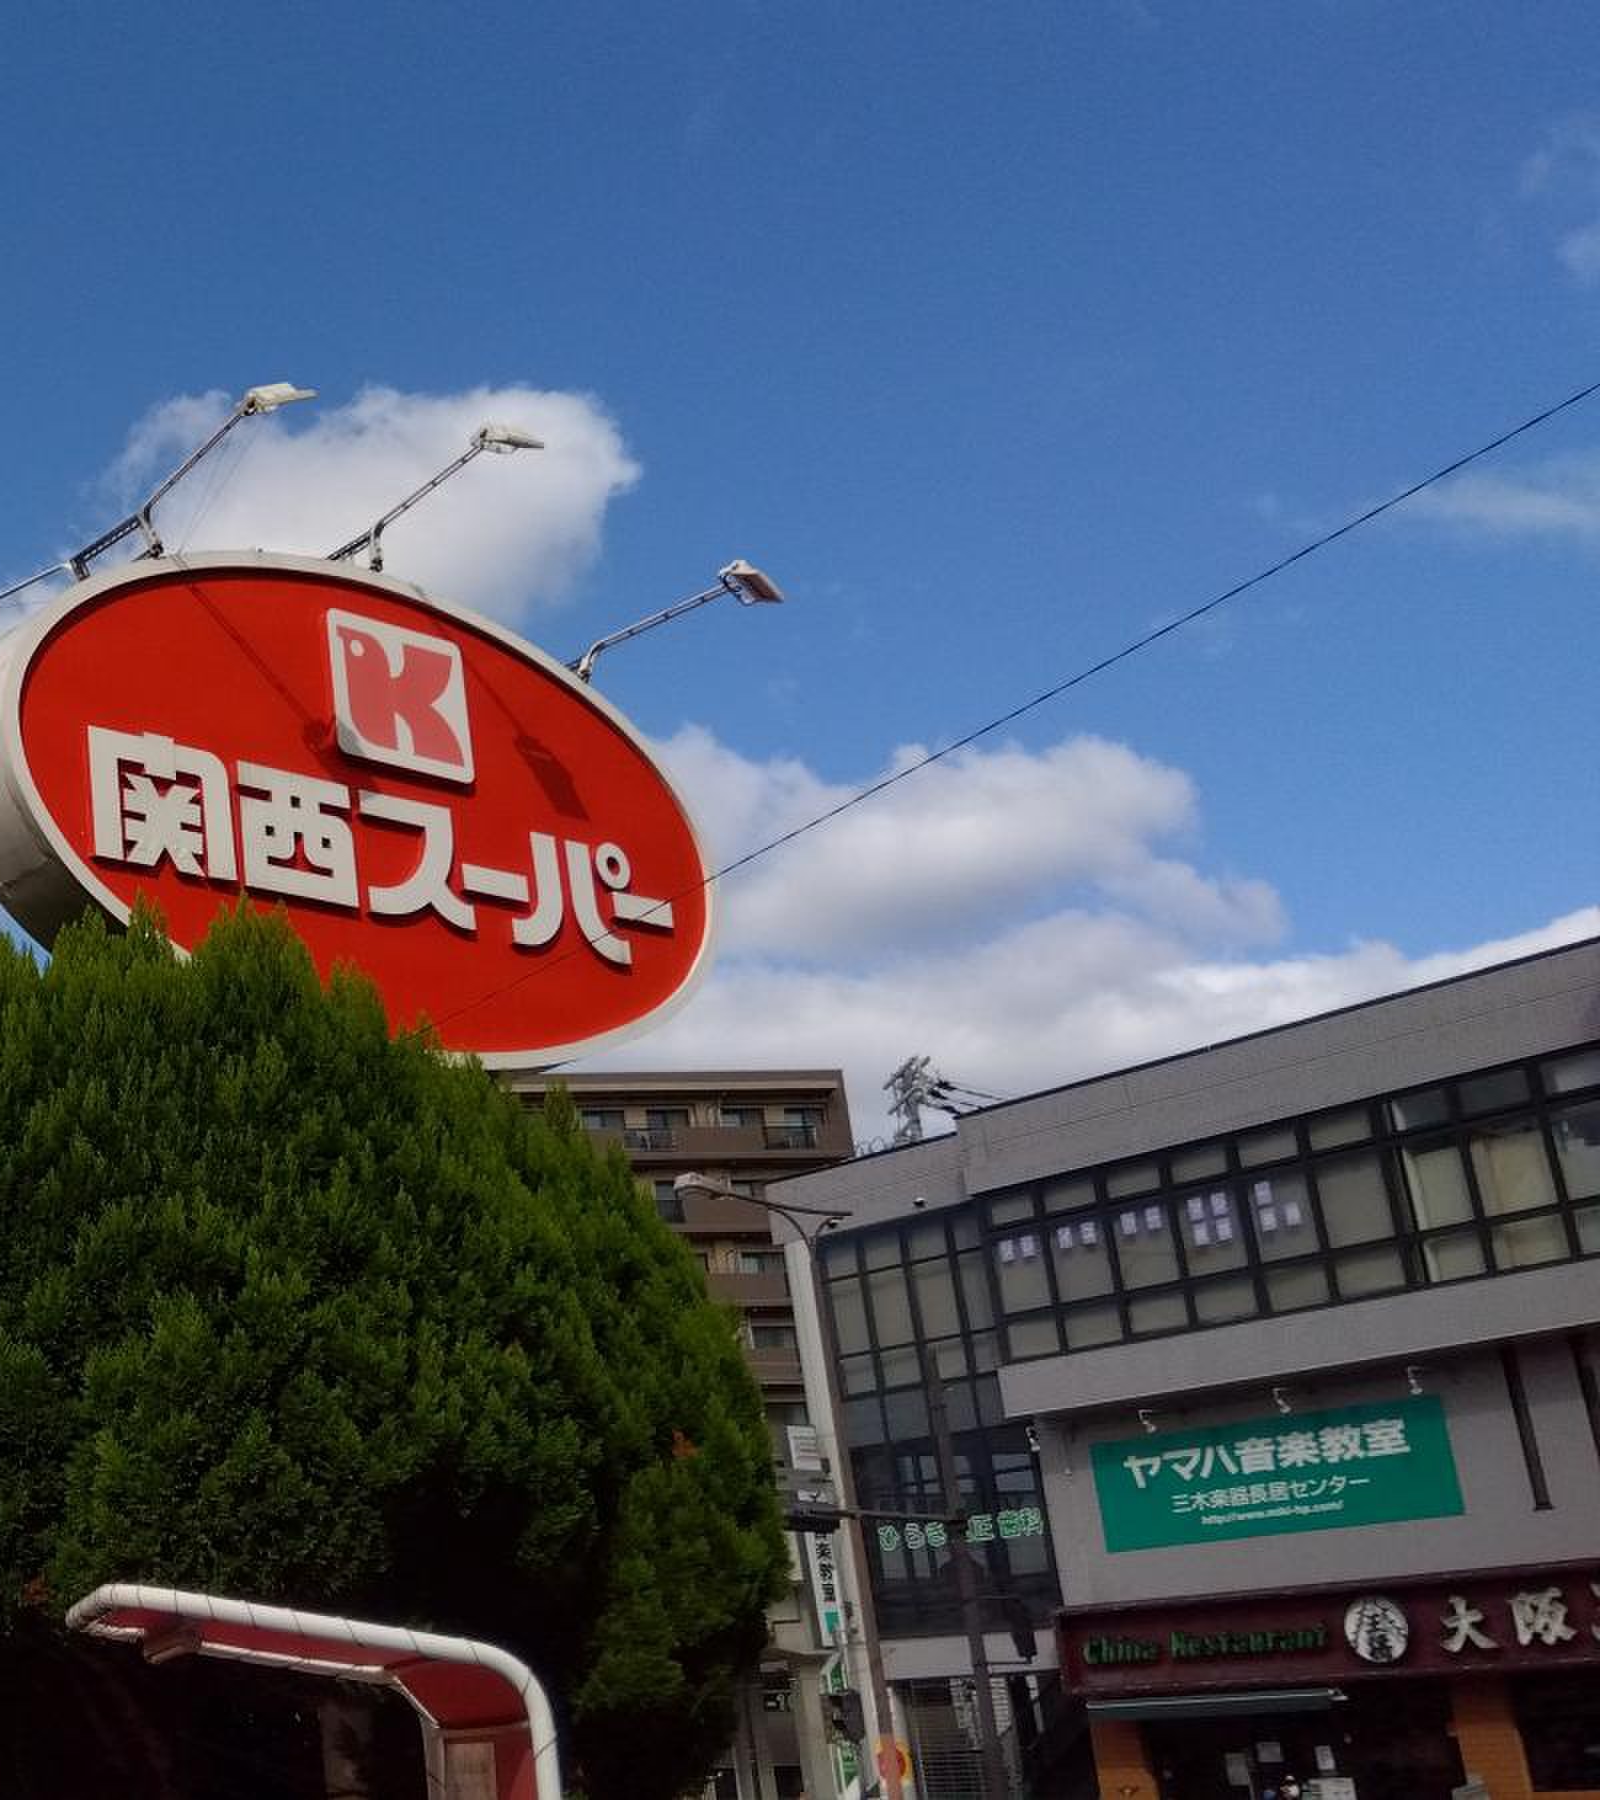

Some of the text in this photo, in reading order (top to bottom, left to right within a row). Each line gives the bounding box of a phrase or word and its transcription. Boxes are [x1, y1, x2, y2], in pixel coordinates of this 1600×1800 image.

[87, 724, 674, 966] 関西スーパー
[1123, 1418, 1412, 1489] ヤマハ音楽教室
[1082, 1621, 1329, 1665] China Restaurant
[1439, 1586, 1600, 1653] 大阪
